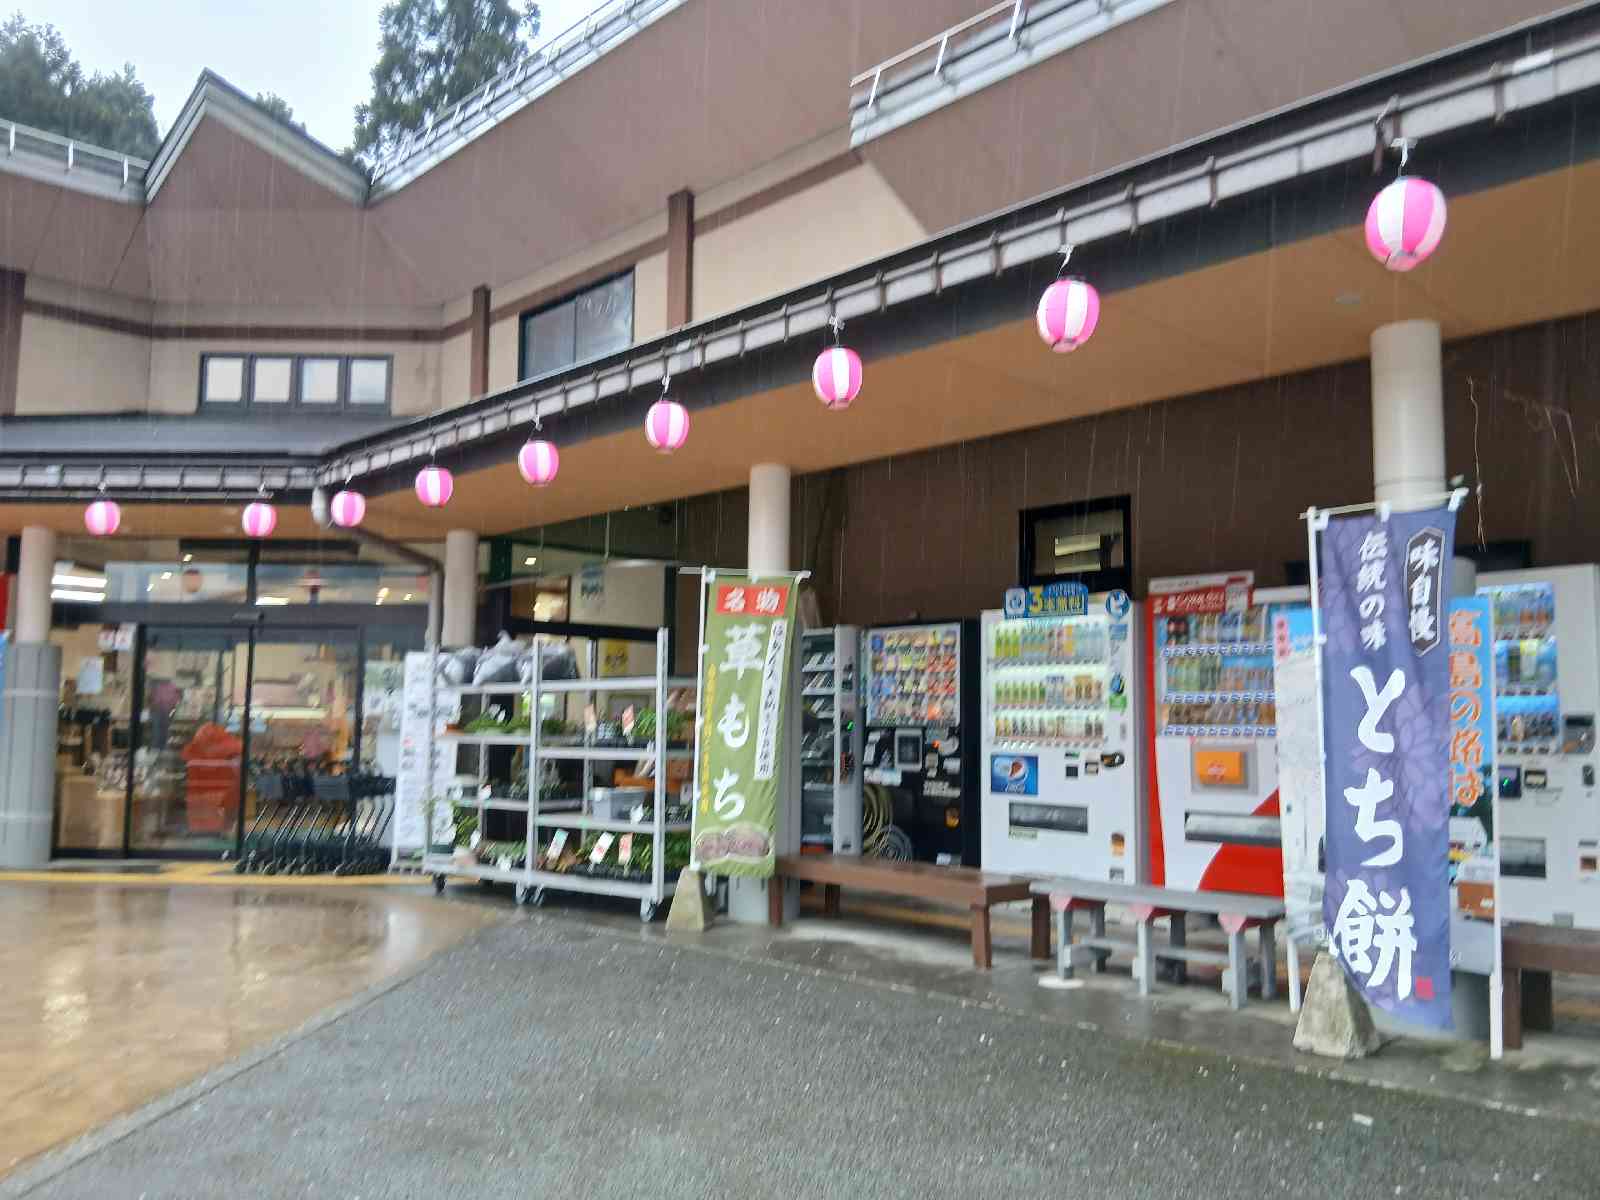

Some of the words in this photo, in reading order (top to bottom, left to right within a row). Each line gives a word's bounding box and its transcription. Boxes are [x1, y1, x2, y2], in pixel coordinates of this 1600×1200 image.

[724, 586, 780, 613] 名物
[1357, 530, 1388, 651] 伝統の味
[1409, 537, 1440, 643] 味自慢
[713, 622, 768, 822] 草もち
[1329, 664, 1418, 1001] とち餅
